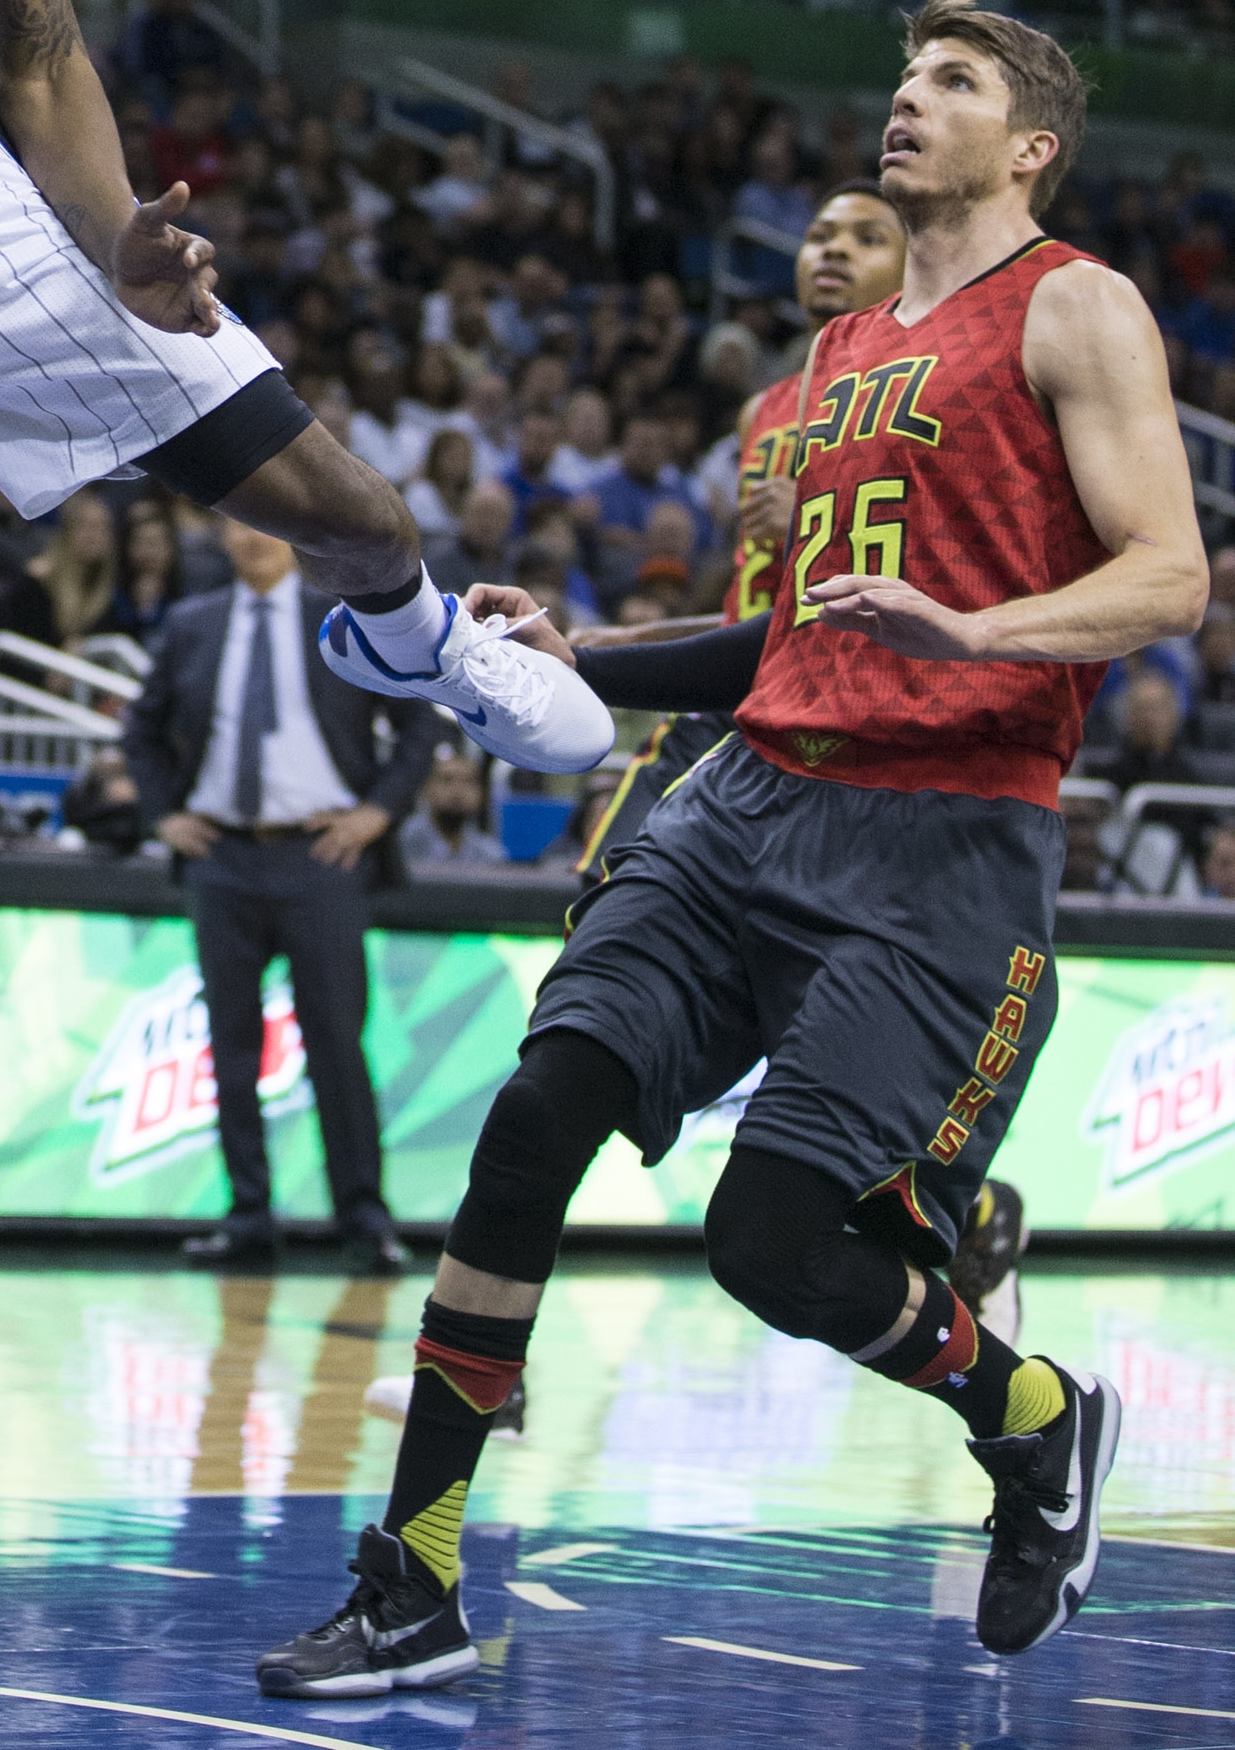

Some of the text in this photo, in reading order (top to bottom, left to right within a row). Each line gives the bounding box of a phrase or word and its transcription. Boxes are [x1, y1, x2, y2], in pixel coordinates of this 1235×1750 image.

[795, 354, 943, 478] ATL
[793, 474, 909, 631] 26
[926, 945, 1046, 1167] HAWKS
